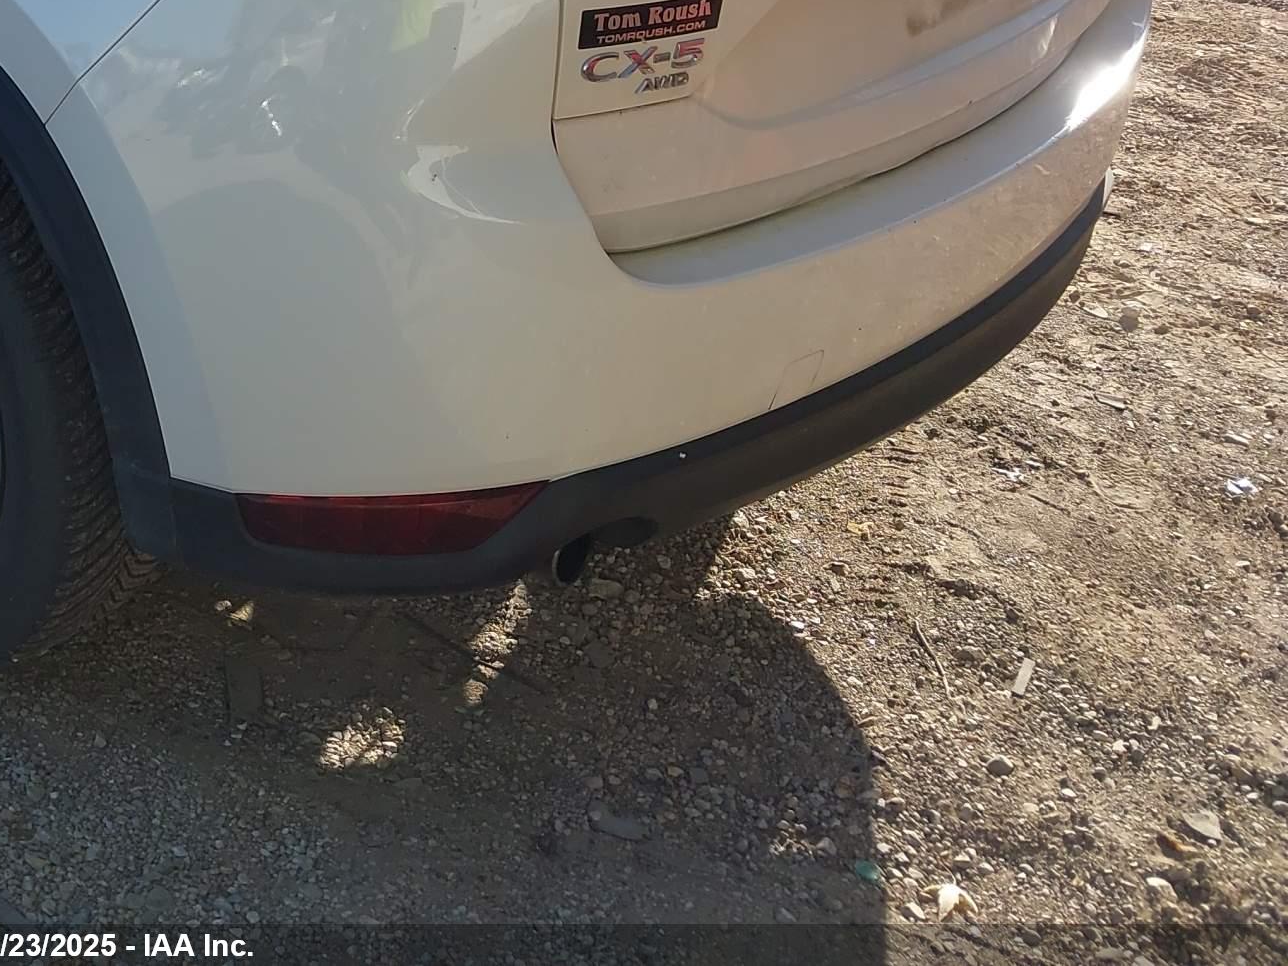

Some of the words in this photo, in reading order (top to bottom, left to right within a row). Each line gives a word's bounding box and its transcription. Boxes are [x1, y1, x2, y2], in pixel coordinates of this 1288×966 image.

[594, 11, 642, 32] Tom
[596, 20, 706, 45] TOMROUSH.COM
[580, 37, 705, 83] CX-5
[634, 71, 690, 94] AWD
